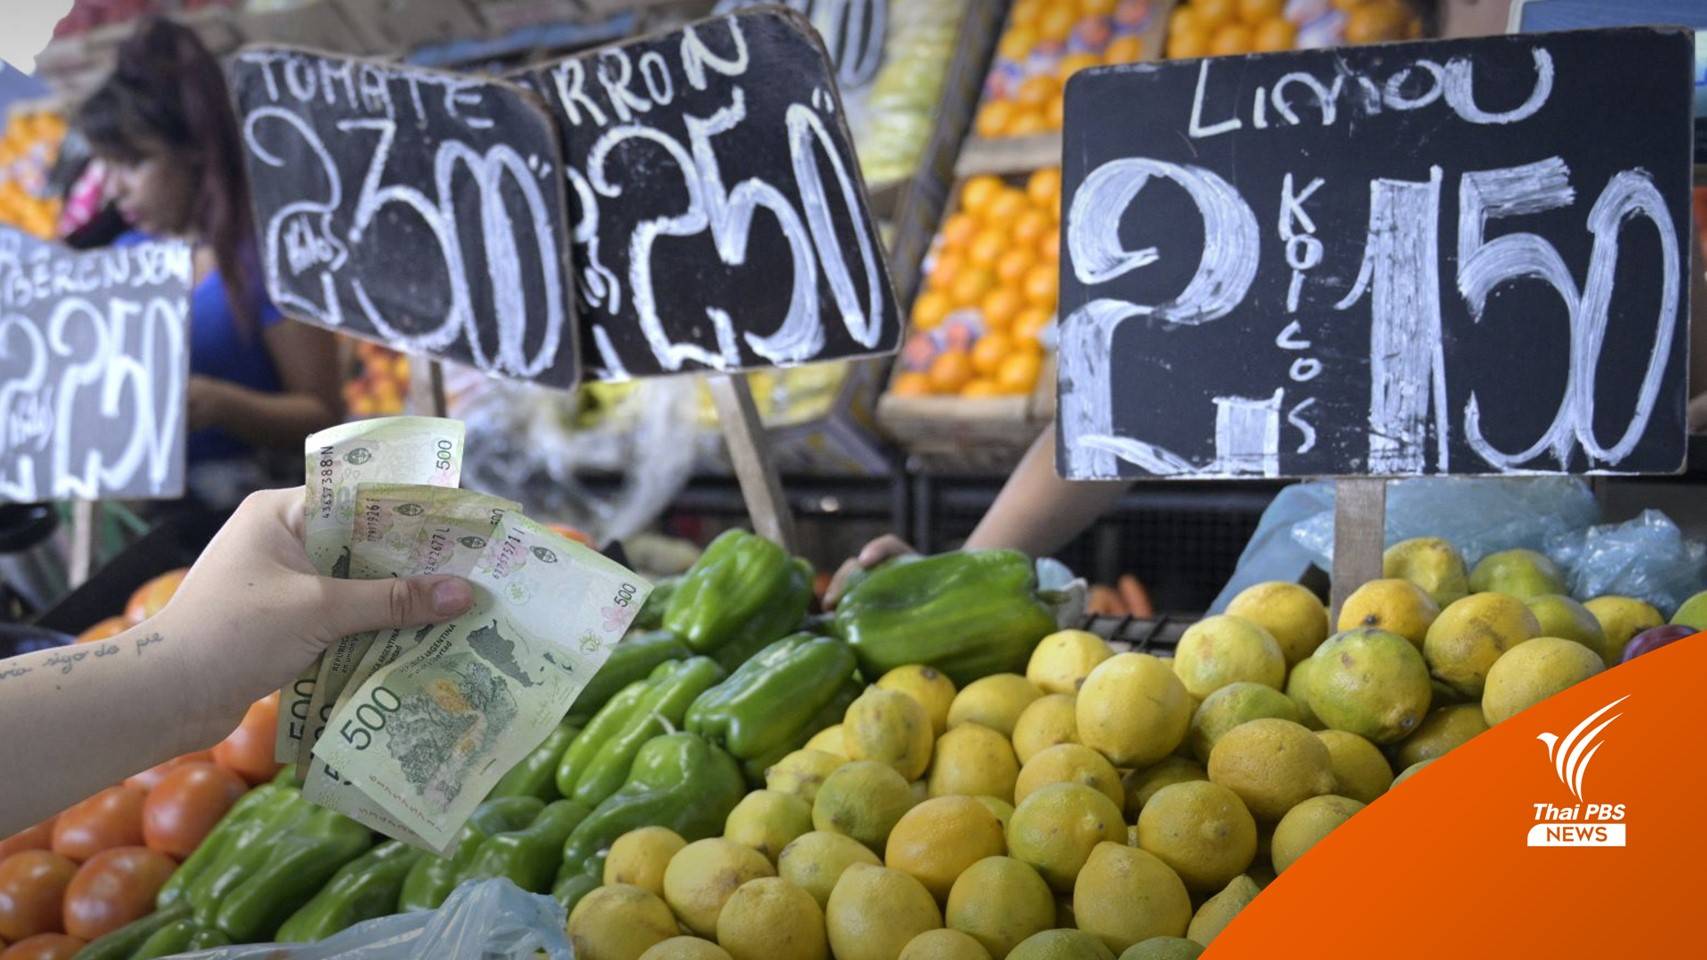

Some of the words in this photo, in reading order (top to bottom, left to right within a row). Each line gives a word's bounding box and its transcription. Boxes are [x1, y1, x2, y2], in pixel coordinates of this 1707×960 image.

[240, 52, 494, 130] TOMATE
[519, 14, 749, 127] RRON
[1057, 157, 1283, 477] 2
[436, 440, 453, 471] 500
[613, 583, 638, 608] 500
[340, 686, 401, 750] 500
